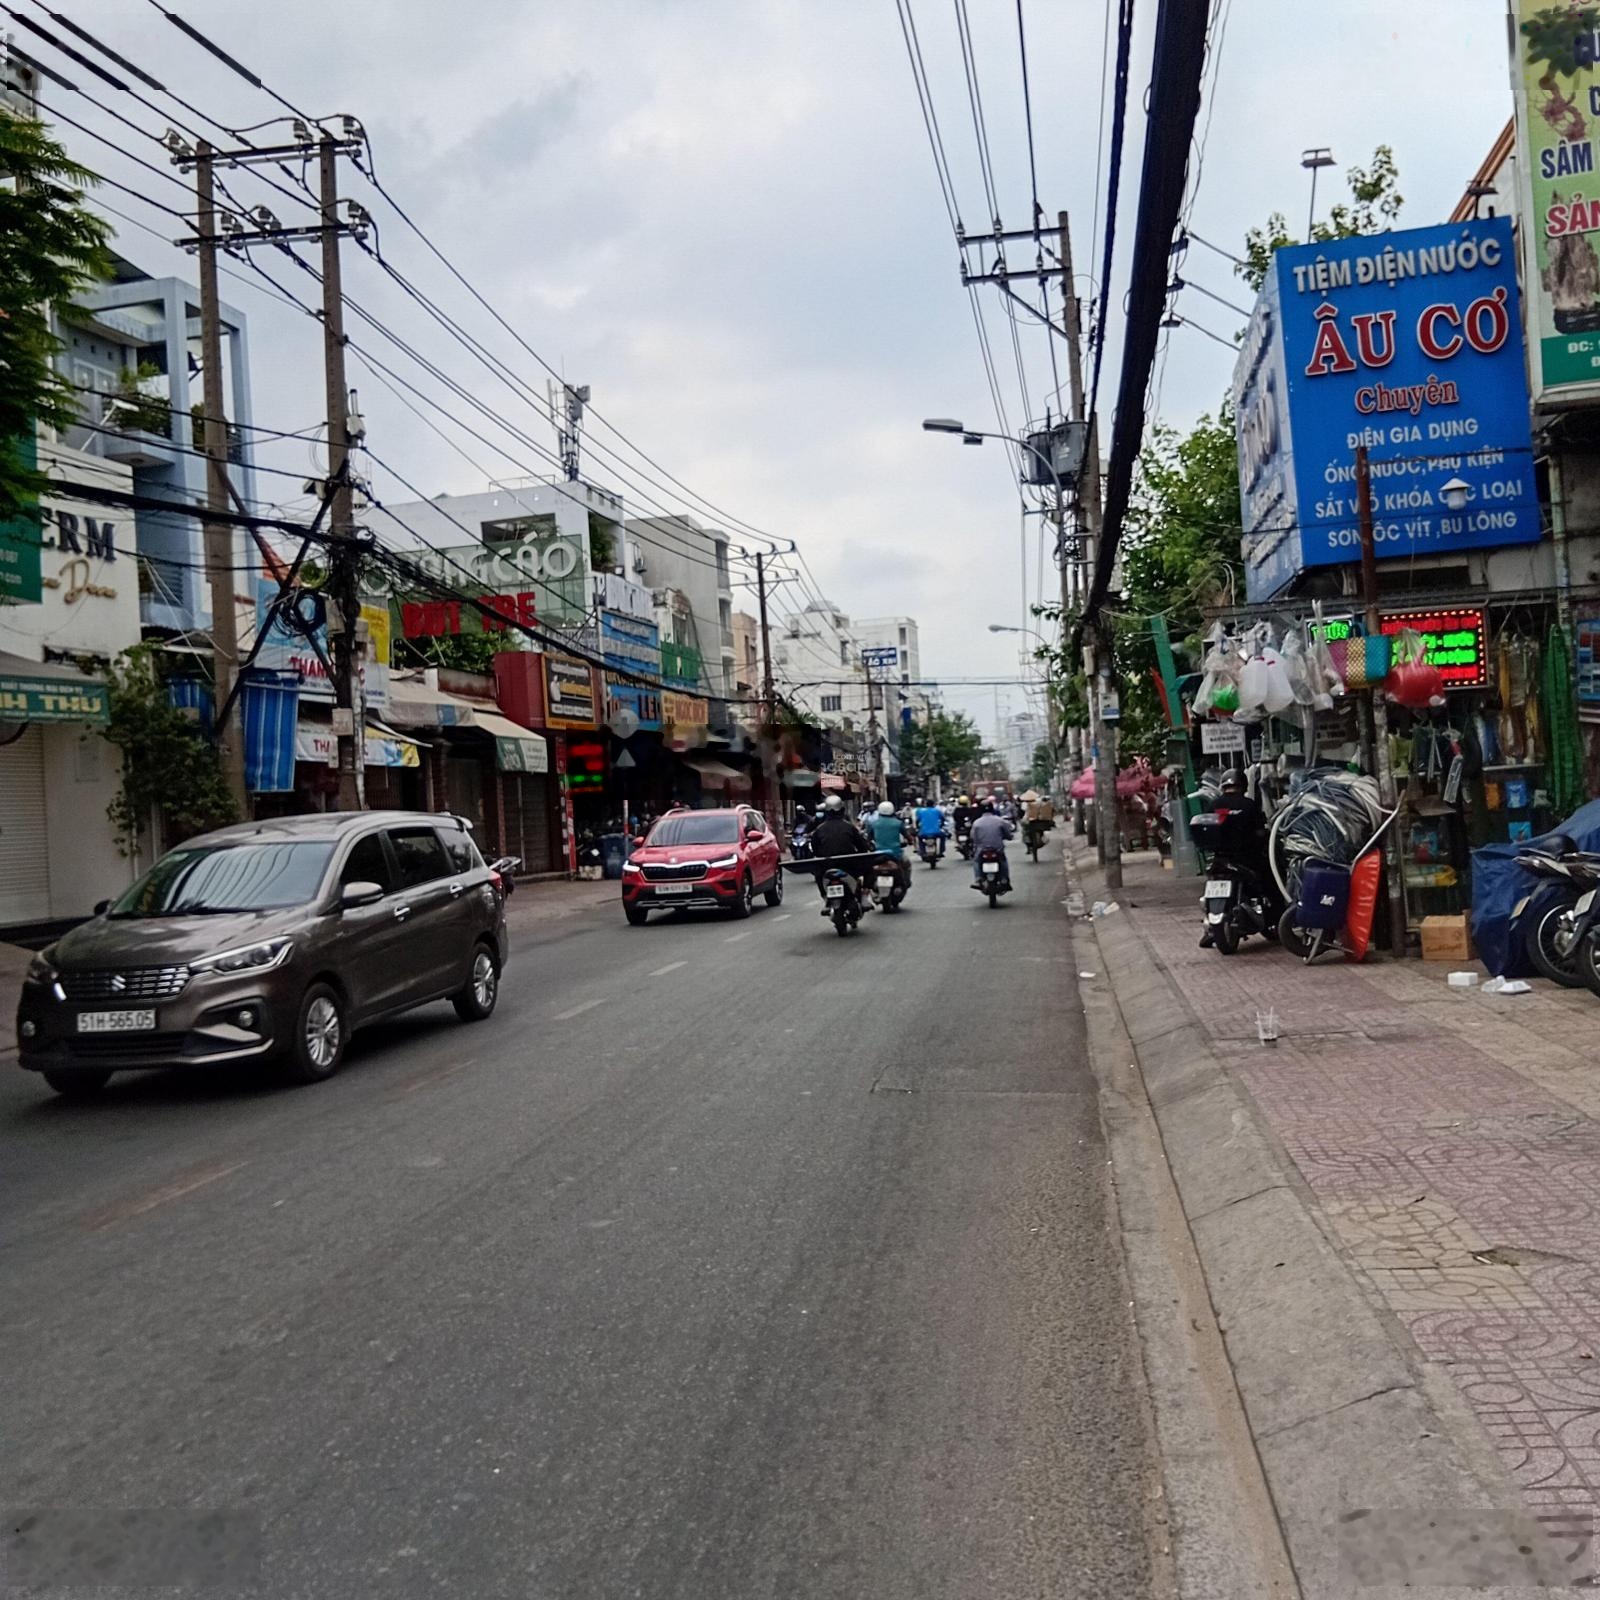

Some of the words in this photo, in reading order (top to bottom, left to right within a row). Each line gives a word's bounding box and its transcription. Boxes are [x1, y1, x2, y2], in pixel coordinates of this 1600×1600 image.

[1541, 140, 1593, 179] SÂM
[1293, 254, 1352, 297] TIỆM
[1356, 245, 1415, 288] ĐIỆN
[1419, 229, 1501, 276] NƯỚC
[1305, 301, 1397, 376] ÂU
[1416, 286, 1509, 359] CƠ
[1355, 374, 1459, 415] Chuyên
[1347, 426, 1385, 451] ĐIỆN
[1390, 425, 1422, 443] GIA
[1429, 418, 1478, 442] DỤNG
[1467, 445, 1504, 469] KIỆN
[1315, 491, 1343, 518] SẮT
[1384, 485, 1434, 511] KHÓA
[1482, 480, 1522, 501] LOẠI
[1467, 509, 1517, 532] LÔNG
